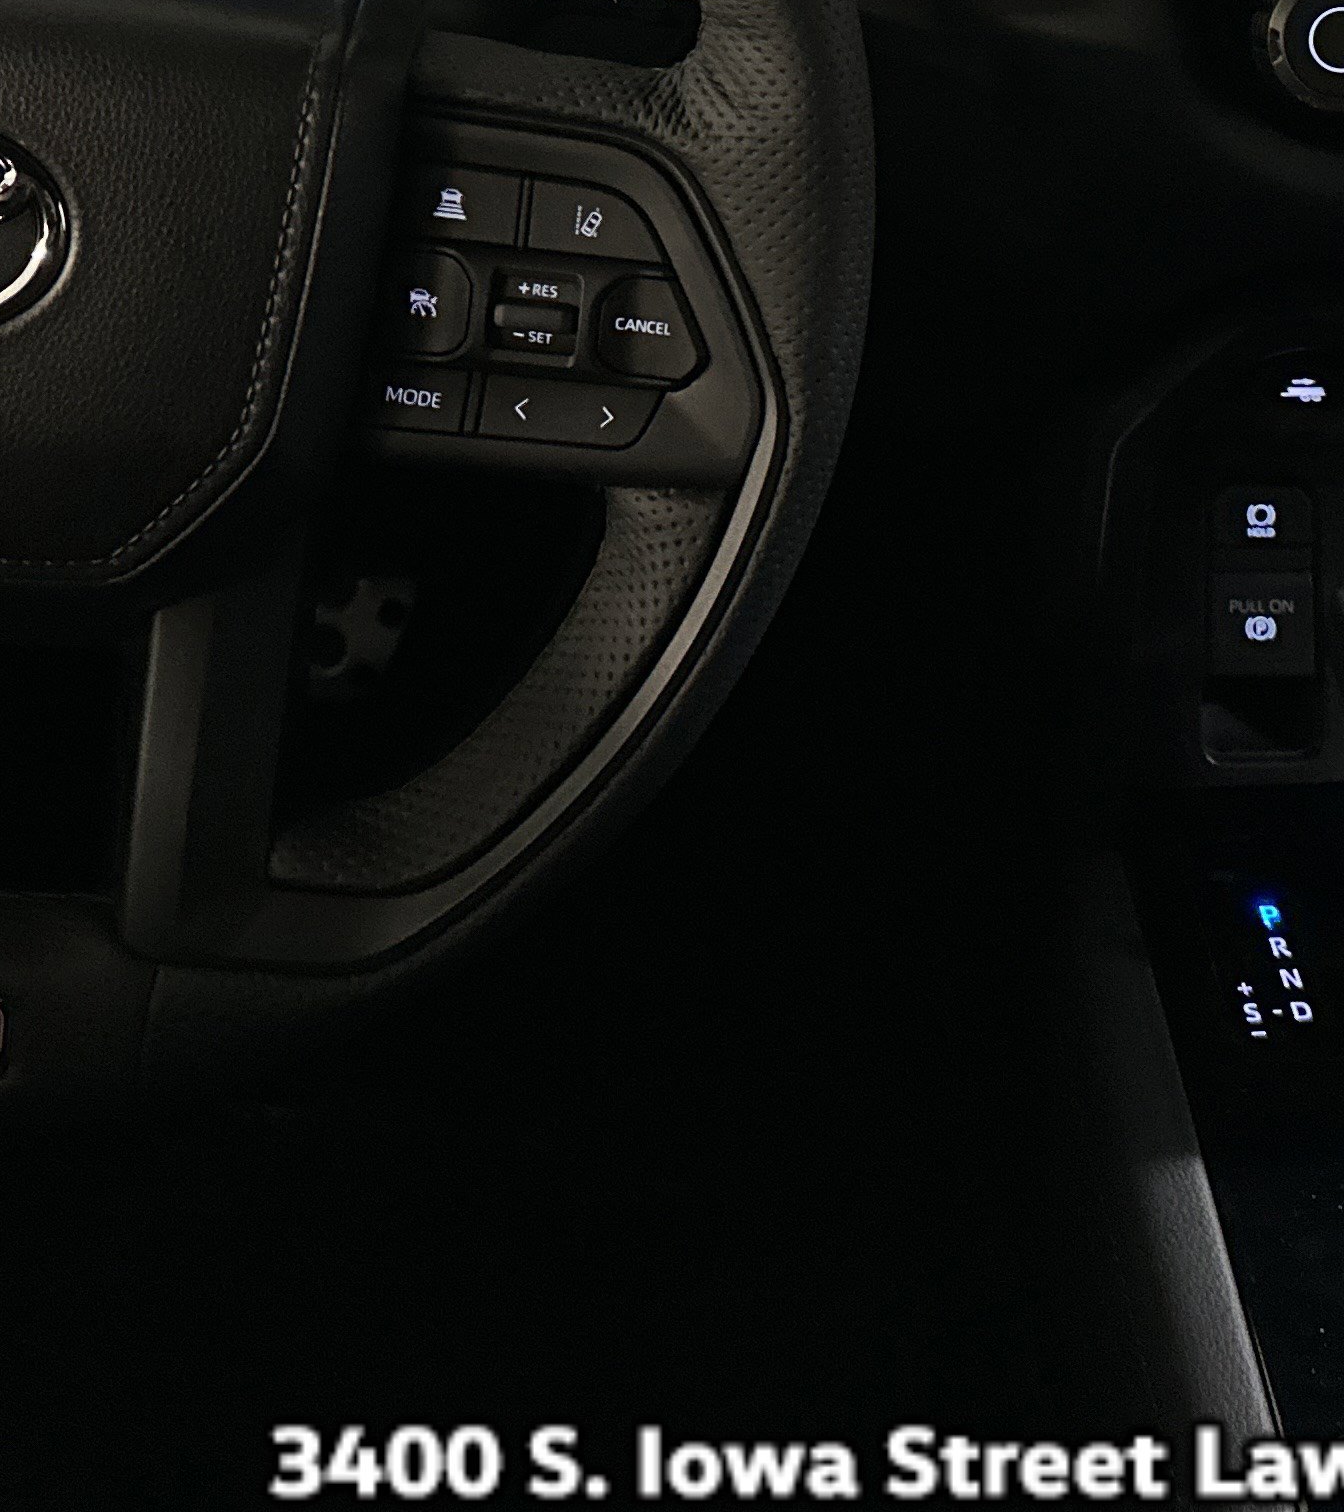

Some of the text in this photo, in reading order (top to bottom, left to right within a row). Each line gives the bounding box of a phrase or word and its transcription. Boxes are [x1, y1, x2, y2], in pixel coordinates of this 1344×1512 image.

[615, 317, 671, 337] CANCEL
[385, 386, 442, 409] MODE
[1228, 598, 1295, 614] PULL ON
[1258, 904, 1282, 930] P
[1268, 937, 1293, 959] R
[1279, 968, 1304, 989] N
[1243, 1002, 1263, 1024] S
[1290, 1001, 1313, 1023] D
